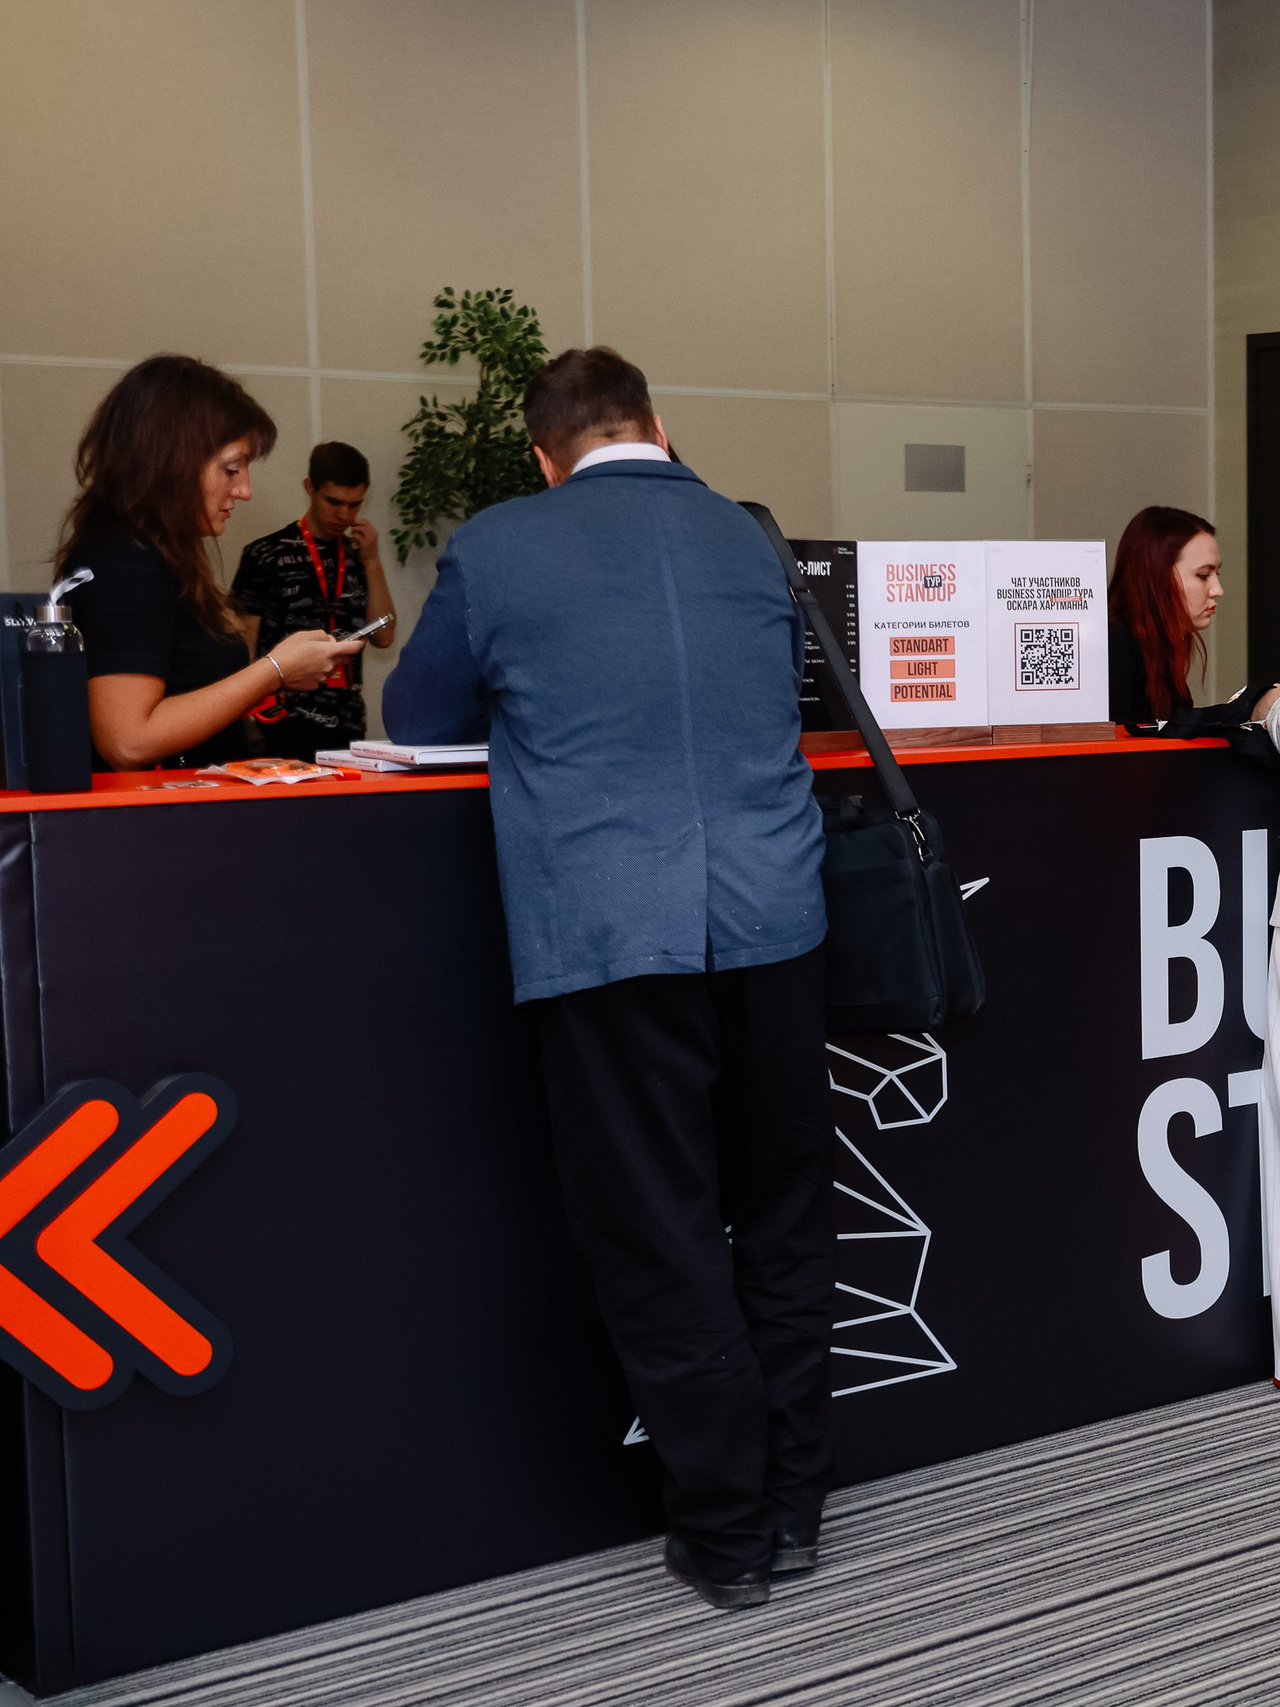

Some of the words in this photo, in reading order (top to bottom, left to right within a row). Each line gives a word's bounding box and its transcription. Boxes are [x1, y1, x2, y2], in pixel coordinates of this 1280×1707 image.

[797, 560, 832, 576] С-ЛИСТ
[886, 563, 957, 582] BUSINESS
[925, 576, 941, 587] ТУР
[1011, 577, 1027, 587] ЧАТ
[1028, 577, 1081, 587] УЧАСТНИКОВ
[886, 583, 957, 602] STANDUP
[996, 588, 1035, 599] BUSINESS
[1036, 588, 1072, 598] STANDUP
[1073, 588, 1094, 598] ТУРА
[1006, 600, 1038, 610] ОСКАРА
[1040, 600, 1089, 610] ХАРТМАННА
[874, 621, 927, 629] КАТЕГОРИИ
[929, 620, 970, 628] БИЛЕТОВ
[893, 638, 949, 653] STANDART
[907, 662, 938, 676] LIGHT
[894, 684, 953, 699] POTENTIAL
